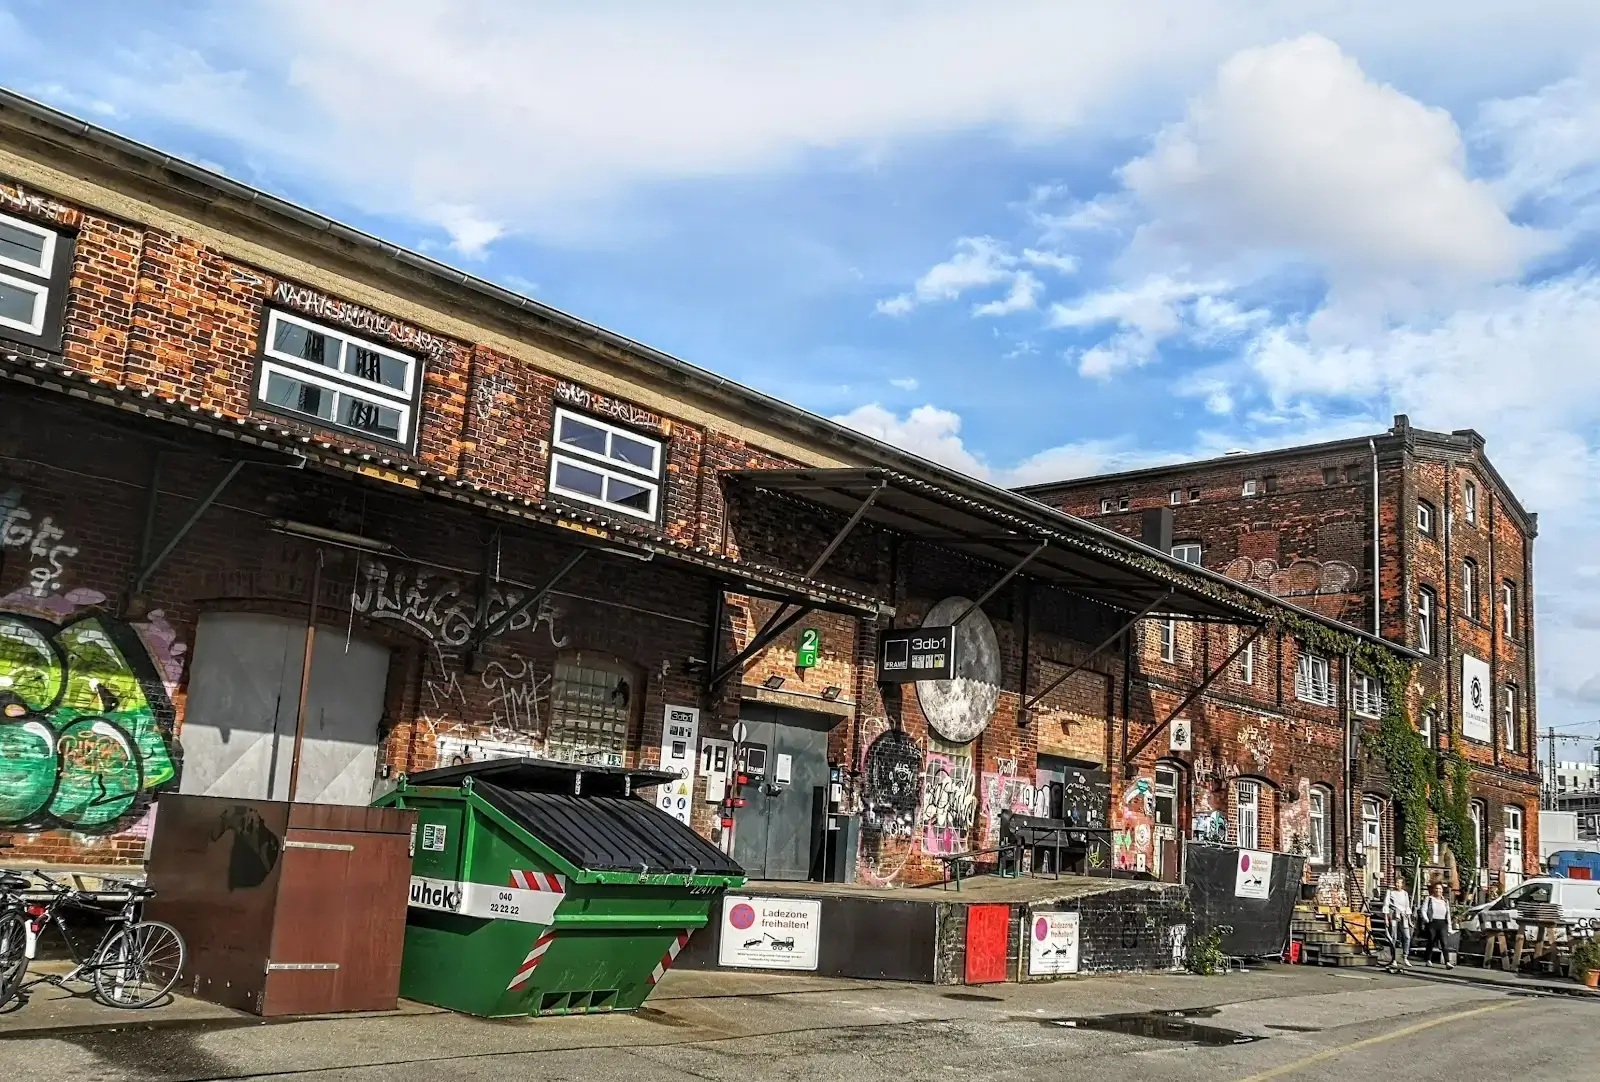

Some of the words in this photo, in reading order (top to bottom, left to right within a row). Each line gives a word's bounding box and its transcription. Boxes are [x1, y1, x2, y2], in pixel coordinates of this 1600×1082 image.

[803, 630, 816, 650] 2
[912, 637, 946, 650] 3db1
[806, 654, 814, 665] G
[671, 711, 693, 722] 3db1
[499, 892, 513, 901] 040
[490, 903, 499, 912] 22
[500, 904, 509, 913] 22
[510, 906, 519, 915] 22
[762, 908, 808, 919] Ladezone
[761, 918, 809, 930] freihalten!
